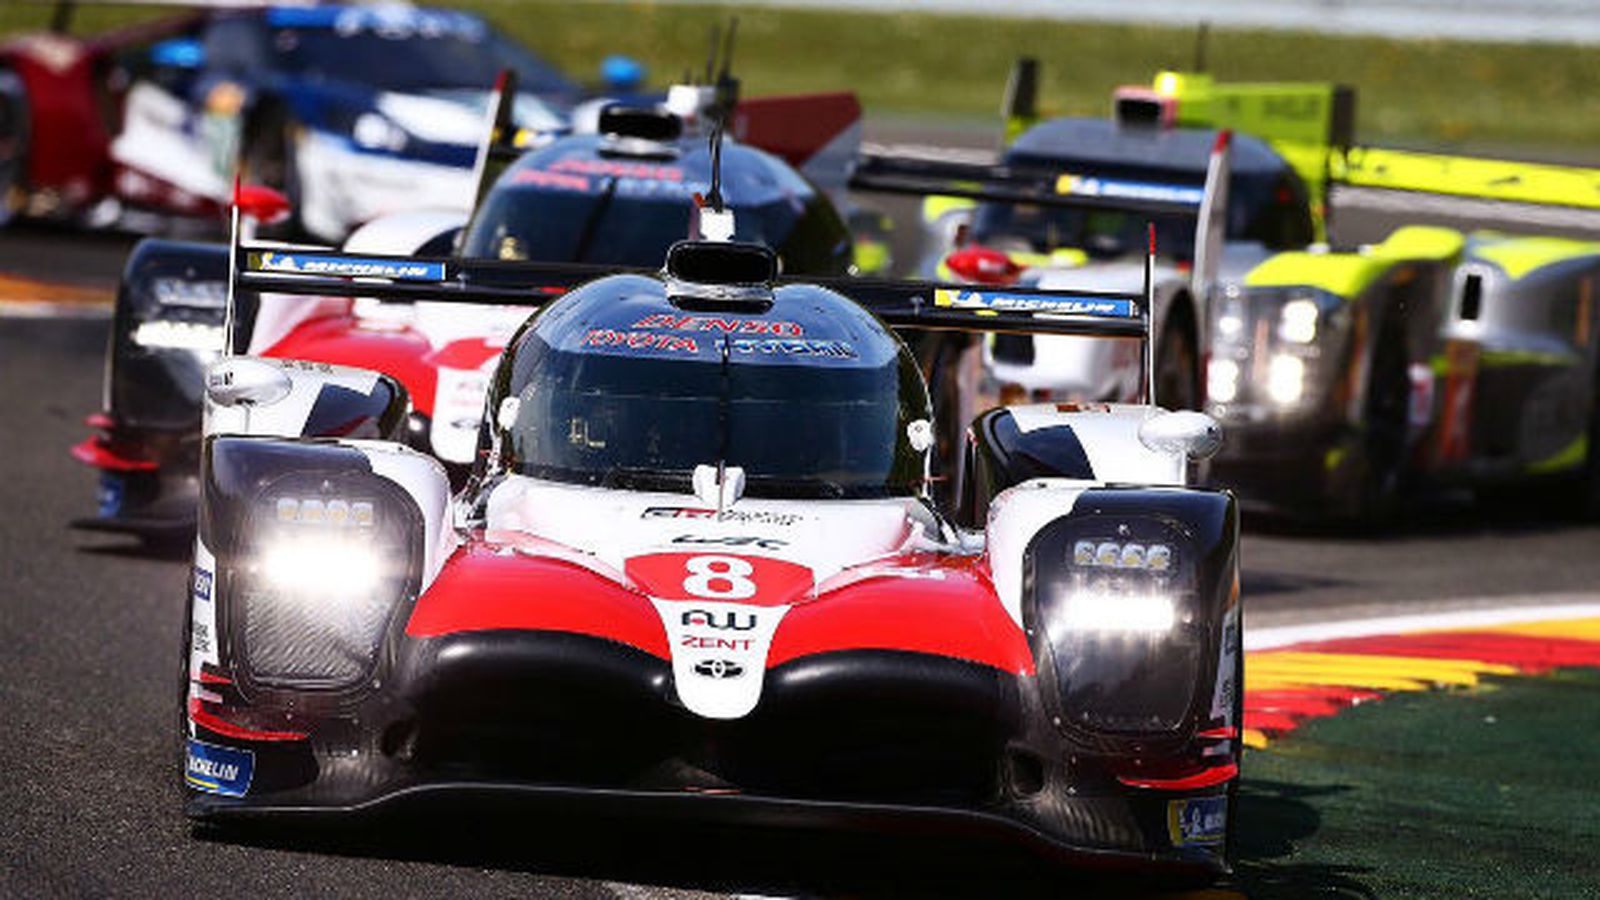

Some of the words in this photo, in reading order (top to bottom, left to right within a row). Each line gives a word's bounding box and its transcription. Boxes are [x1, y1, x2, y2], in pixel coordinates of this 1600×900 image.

[304, 261, 430, 277] MICHELIN
[990, 297, 1117, 312] MICHELIN
[631, 313, 804, 337] DENSO
[580, 329, 699, 352] TOYOTA
[682, 555, 758, 601] 8
[681, 635, 756, 651] ZENT
